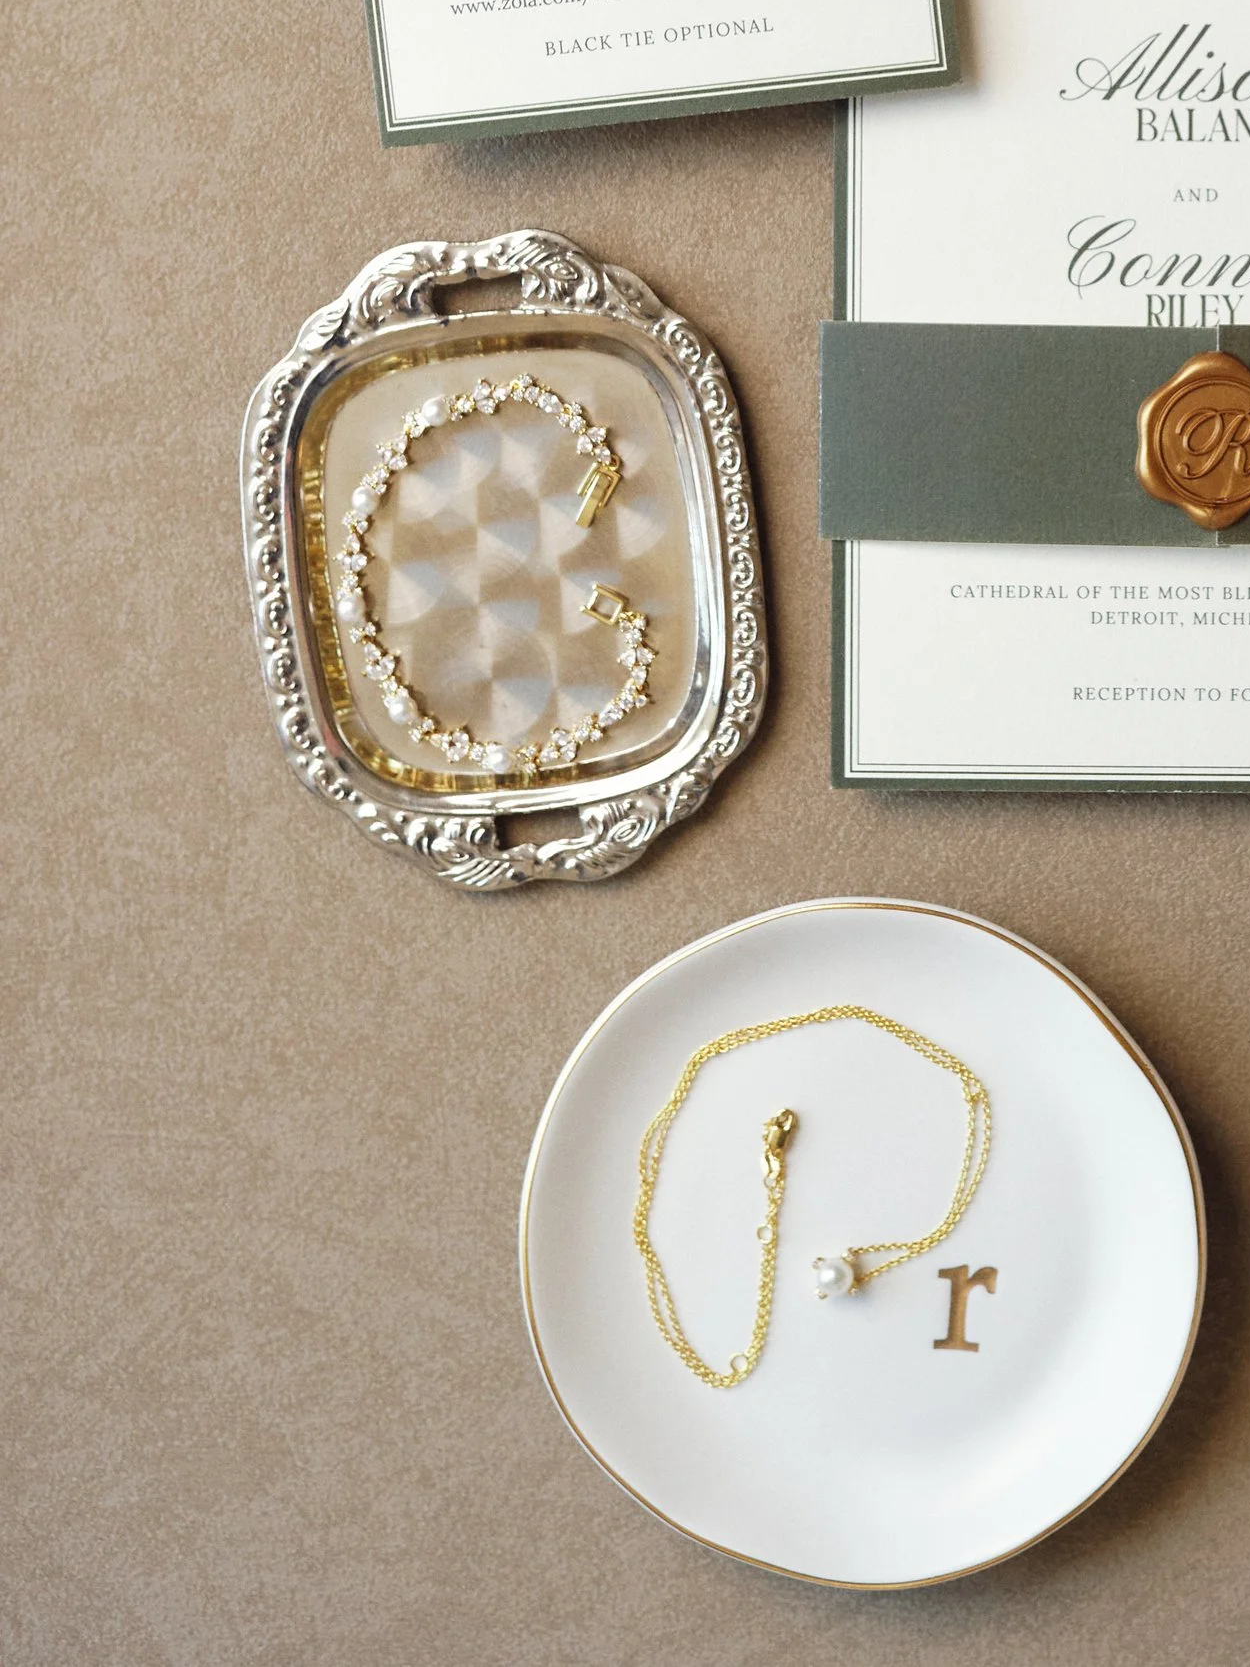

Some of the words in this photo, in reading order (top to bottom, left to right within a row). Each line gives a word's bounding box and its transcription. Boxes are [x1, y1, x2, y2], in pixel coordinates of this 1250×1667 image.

[544, 34, 613, 57] BLACK
[619, 30, 655, 48] TIE
[663, 17, 774, 43] OPTIONAL
[1173, 188, 1219, 202] AND
[1145, 293, 1244, 327] RILEY
[950, 584, 1069, 599] CATHEDRAL
[1076, 585, 1102, 600] OF
[1109, 585, 1149, 600] THE
[1158, 586, 1214, 601] MOST
[1091, 610, 1184, 627] DETROIT,
[1073, 686, 1186, 702] RECEPTION
[1194, 687, 1222, 702] TO
[932, 1263, 998, 1353] r
